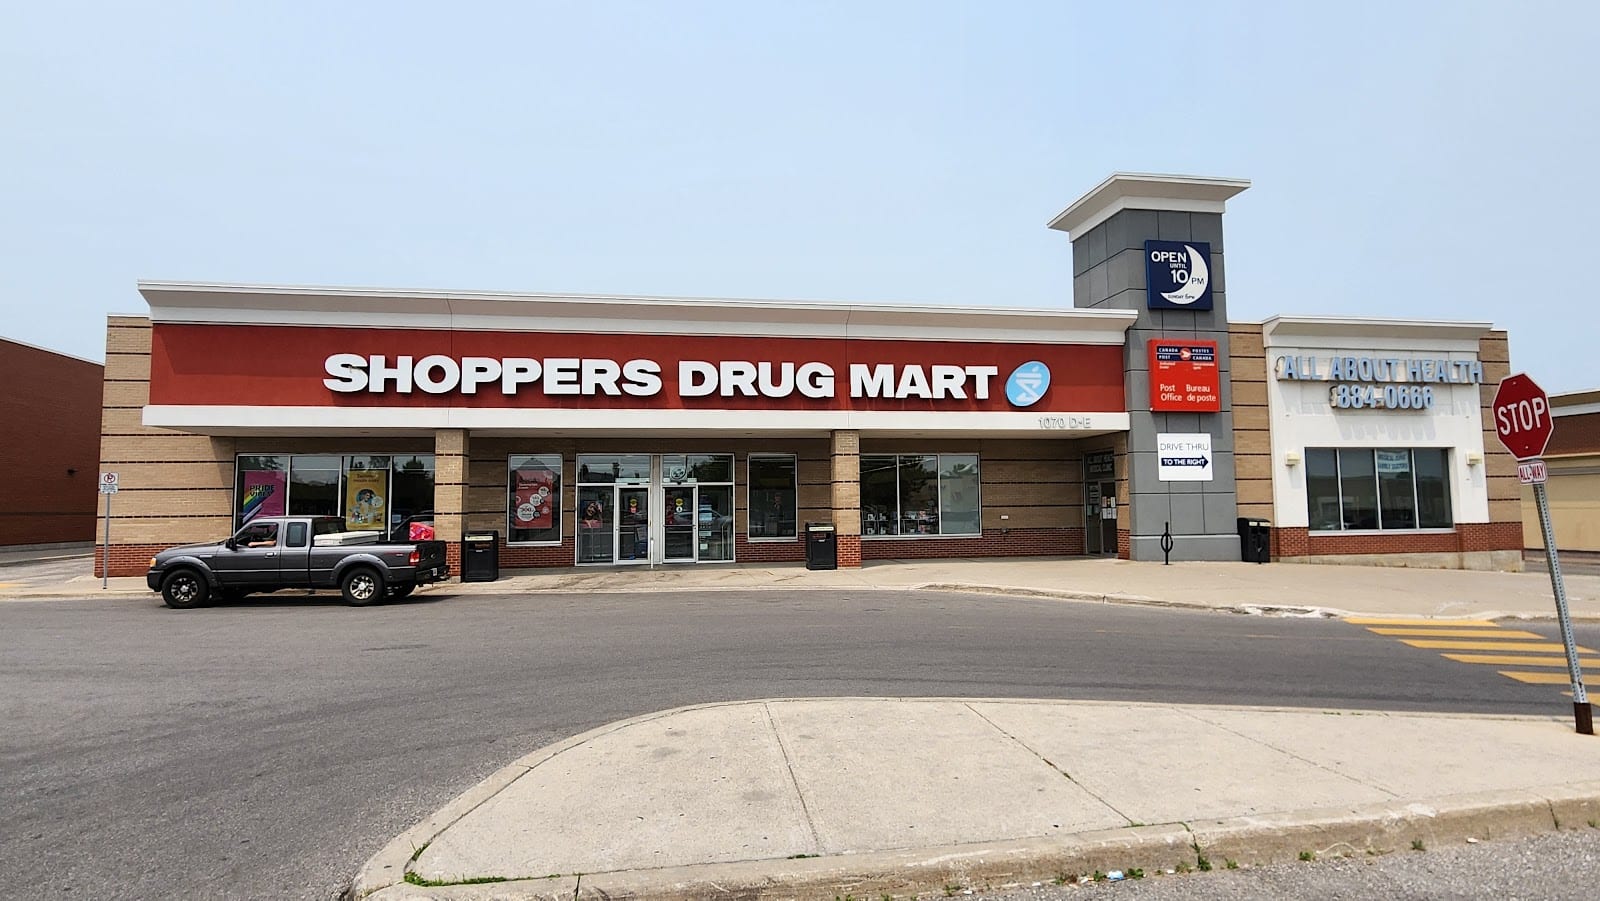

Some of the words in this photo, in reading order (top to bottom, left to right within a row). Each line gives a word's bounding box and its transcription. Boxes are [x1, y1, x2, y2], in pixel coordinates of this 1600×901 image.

[1151, 251, 1187, 263] OPEN
[1170, 269, 1188, 284] 10
[1191, 277, 1205, 285] PM
[1283, 355, 1323, 381] ALL
[1330, 356, 1399, 383] ABOUT
[1407, 359, 1484, 384] HEALTH
[323, 353, 663, 396] SHOPPERS
[678, 360, 835, 399] DRUG
[850, 363, 999, 400] MART
[1160, 383, 1176, 392] Post
[1186, 384, 1211, 393] Bureau
[1160, 392, 1183, 402] Office
[1186, 392, 1196, 402] de
[1196, 394, 1217, 403] poste
[1497, 397, 1546, 436] STOP
[1038, 417, 1066, 429] 1070
[1160, 442, 1184, 451] DRIVE
[1186, 442, 1209, 451] THRU
[1163, 458, 1173, 466] TO
[1186, 458, 1206, 466] RIGHT
[249, 484, 276, 492] PRIDE
